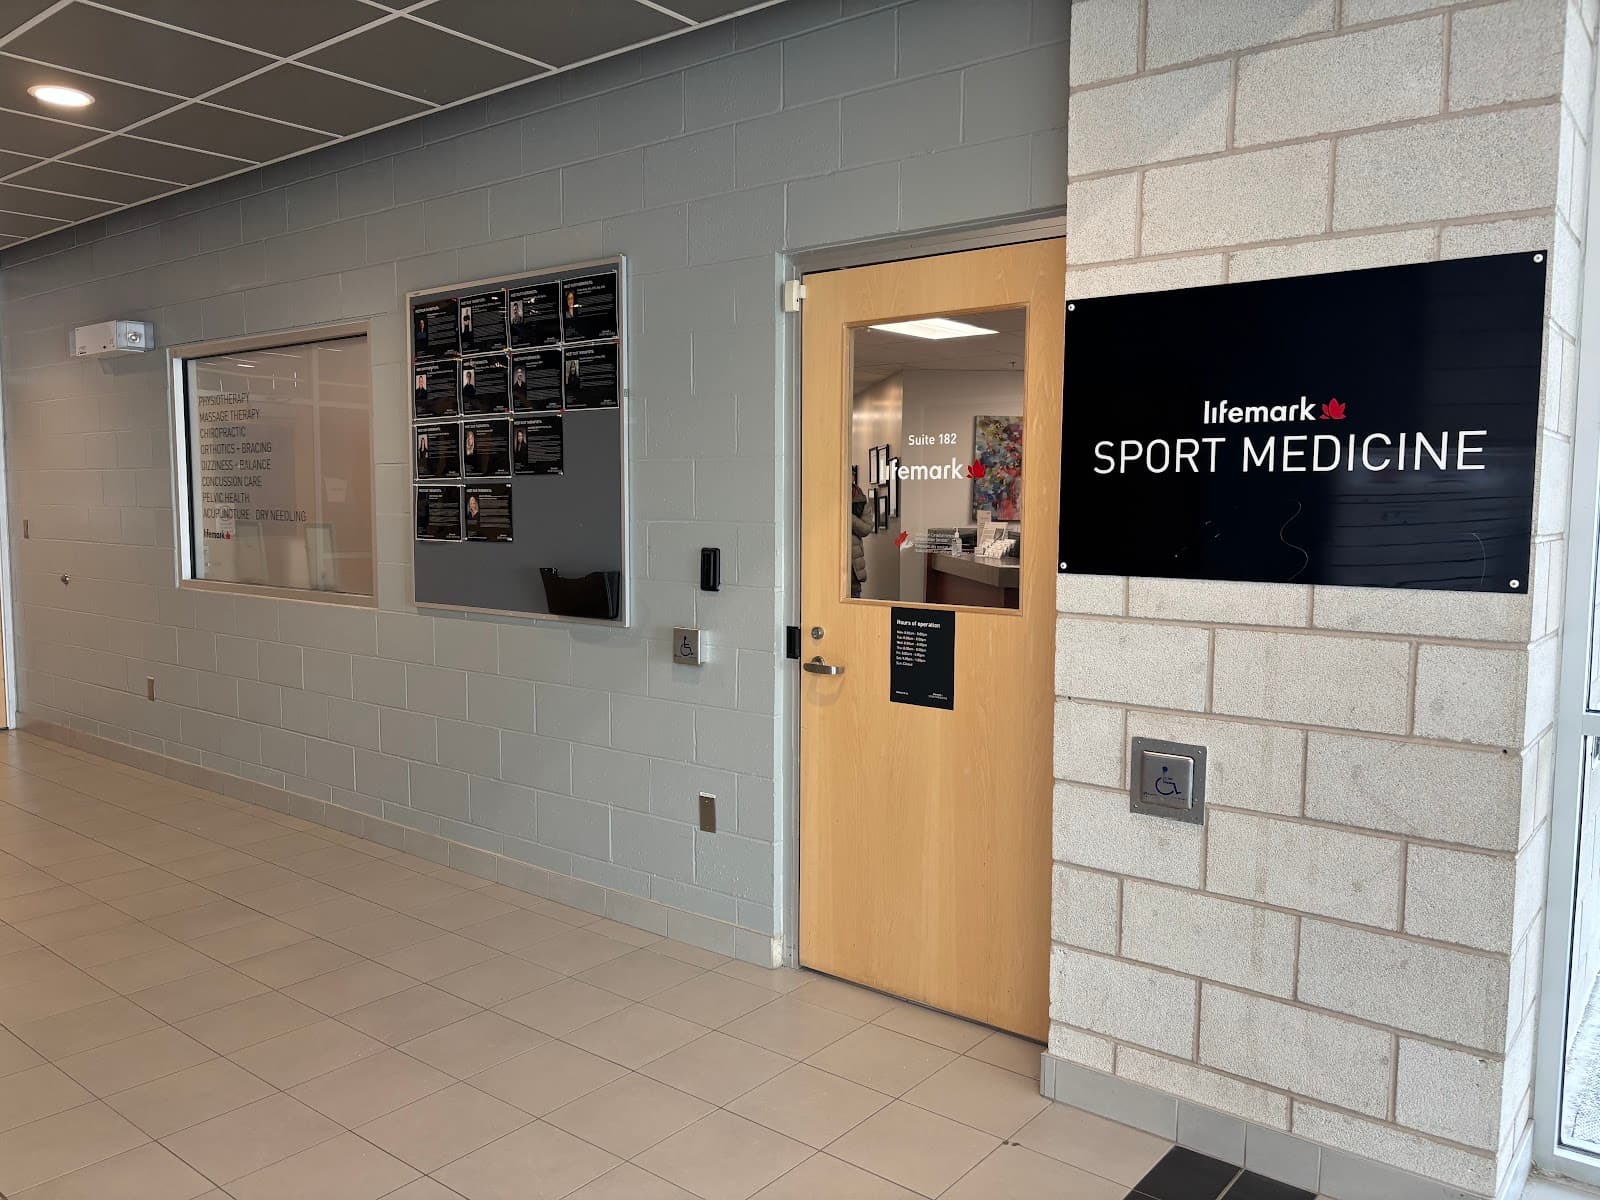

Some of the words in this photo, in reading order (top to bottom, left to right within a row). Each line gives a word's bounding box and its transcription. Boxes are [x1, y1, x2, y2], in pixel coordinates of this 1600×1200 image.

[199, 392, 250, 406] PHYSIOTHERAPY
[200, 411, 228, 423] MASSAGE
[230, 408, 260, 420] THERAPY
[1203, 395, 1316, 424] lifemark
[200, 426, 246, 438] CHIROPRACTIC
[908, 434, 935, 446] Suite
[938, 433, 957, 444] 182
[201, 444, 235, 454] ORTHOTICS
[242, 442, 272, 453] BRACING
[1093, 437, 1225, 474] SPORT
[1242, 430, 1488, 472] MEDICINE
[201, 460, 233, 471] DIZZINESS
[240, 459, 271, 470] BALANCE
[202, 476, 242, 487] CONCUSSION
[244, 476, 263, 486] CARE
[203, 493, 223, 503] PELVIC
[224, 493, 250, 503] HEALTH
[203, 508, 249, 520] ACUPUNCTURE
[255, 509, 269, 520] DRY
[270, 510, 306, 522] NEEDLING
